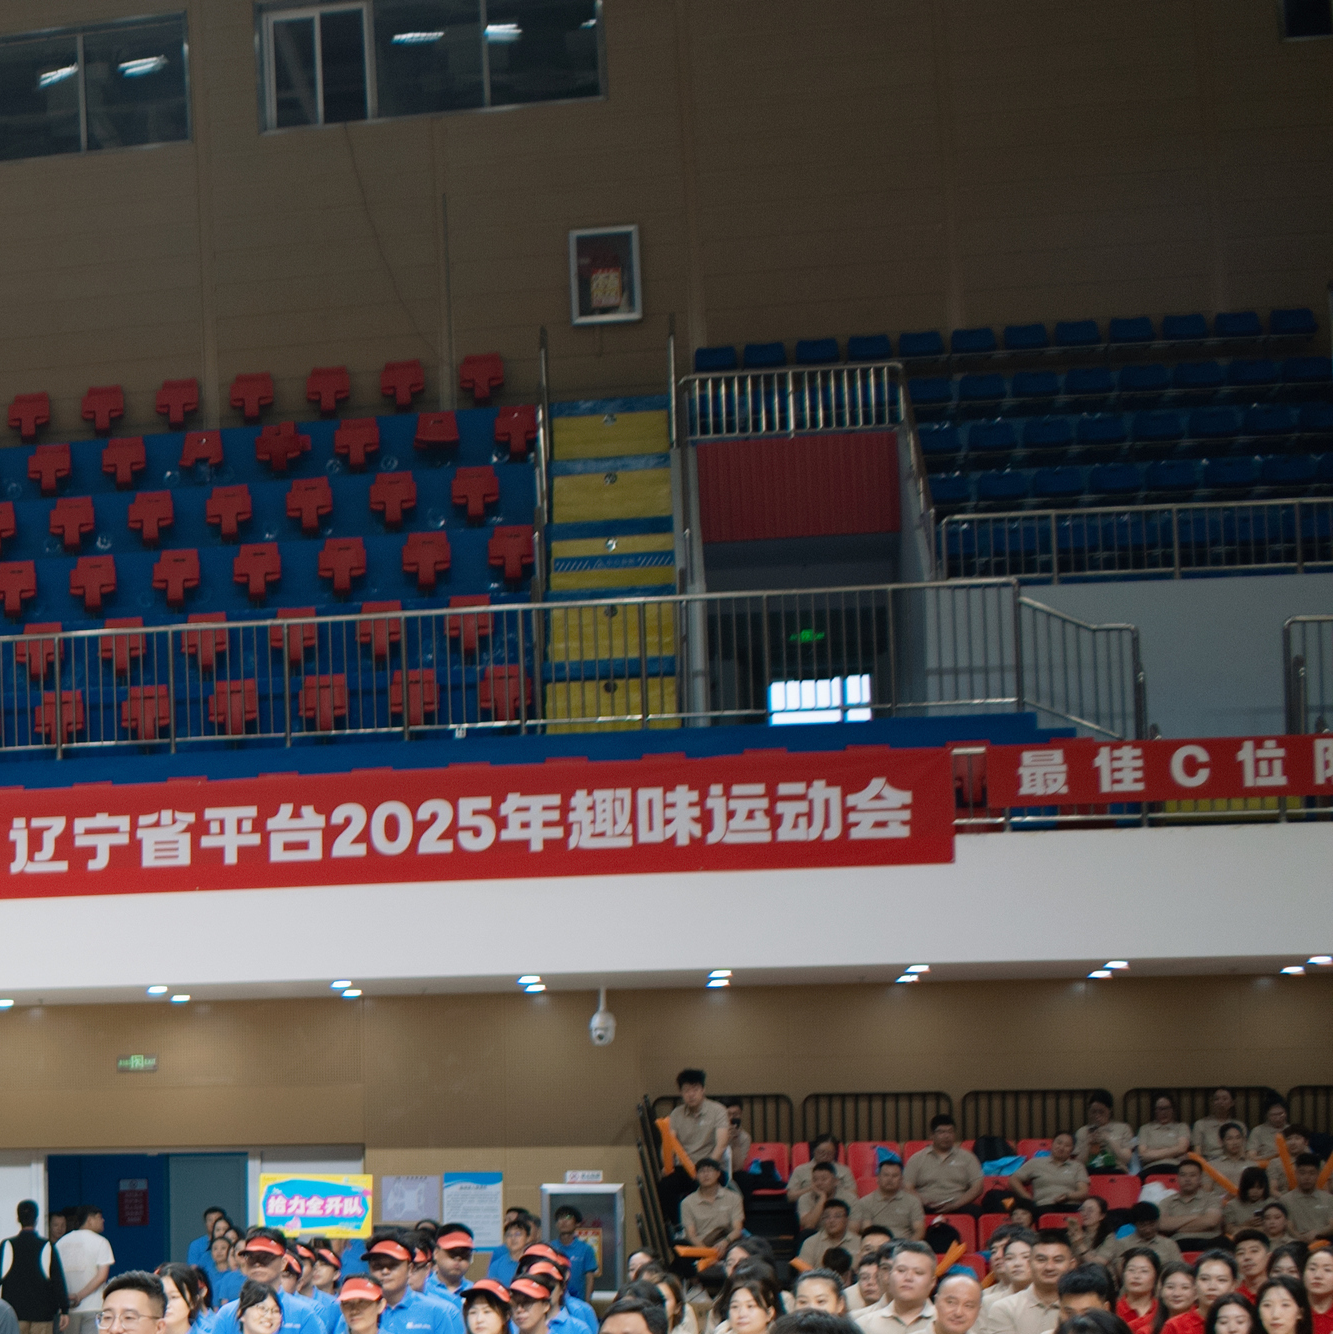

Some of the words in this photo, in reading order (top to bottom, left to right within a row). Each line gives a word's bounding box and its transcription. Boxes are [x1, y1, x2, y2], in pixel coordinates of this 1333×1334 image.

[8, 776, 914, 874] 辽宁省平台2025年趣味运动会
